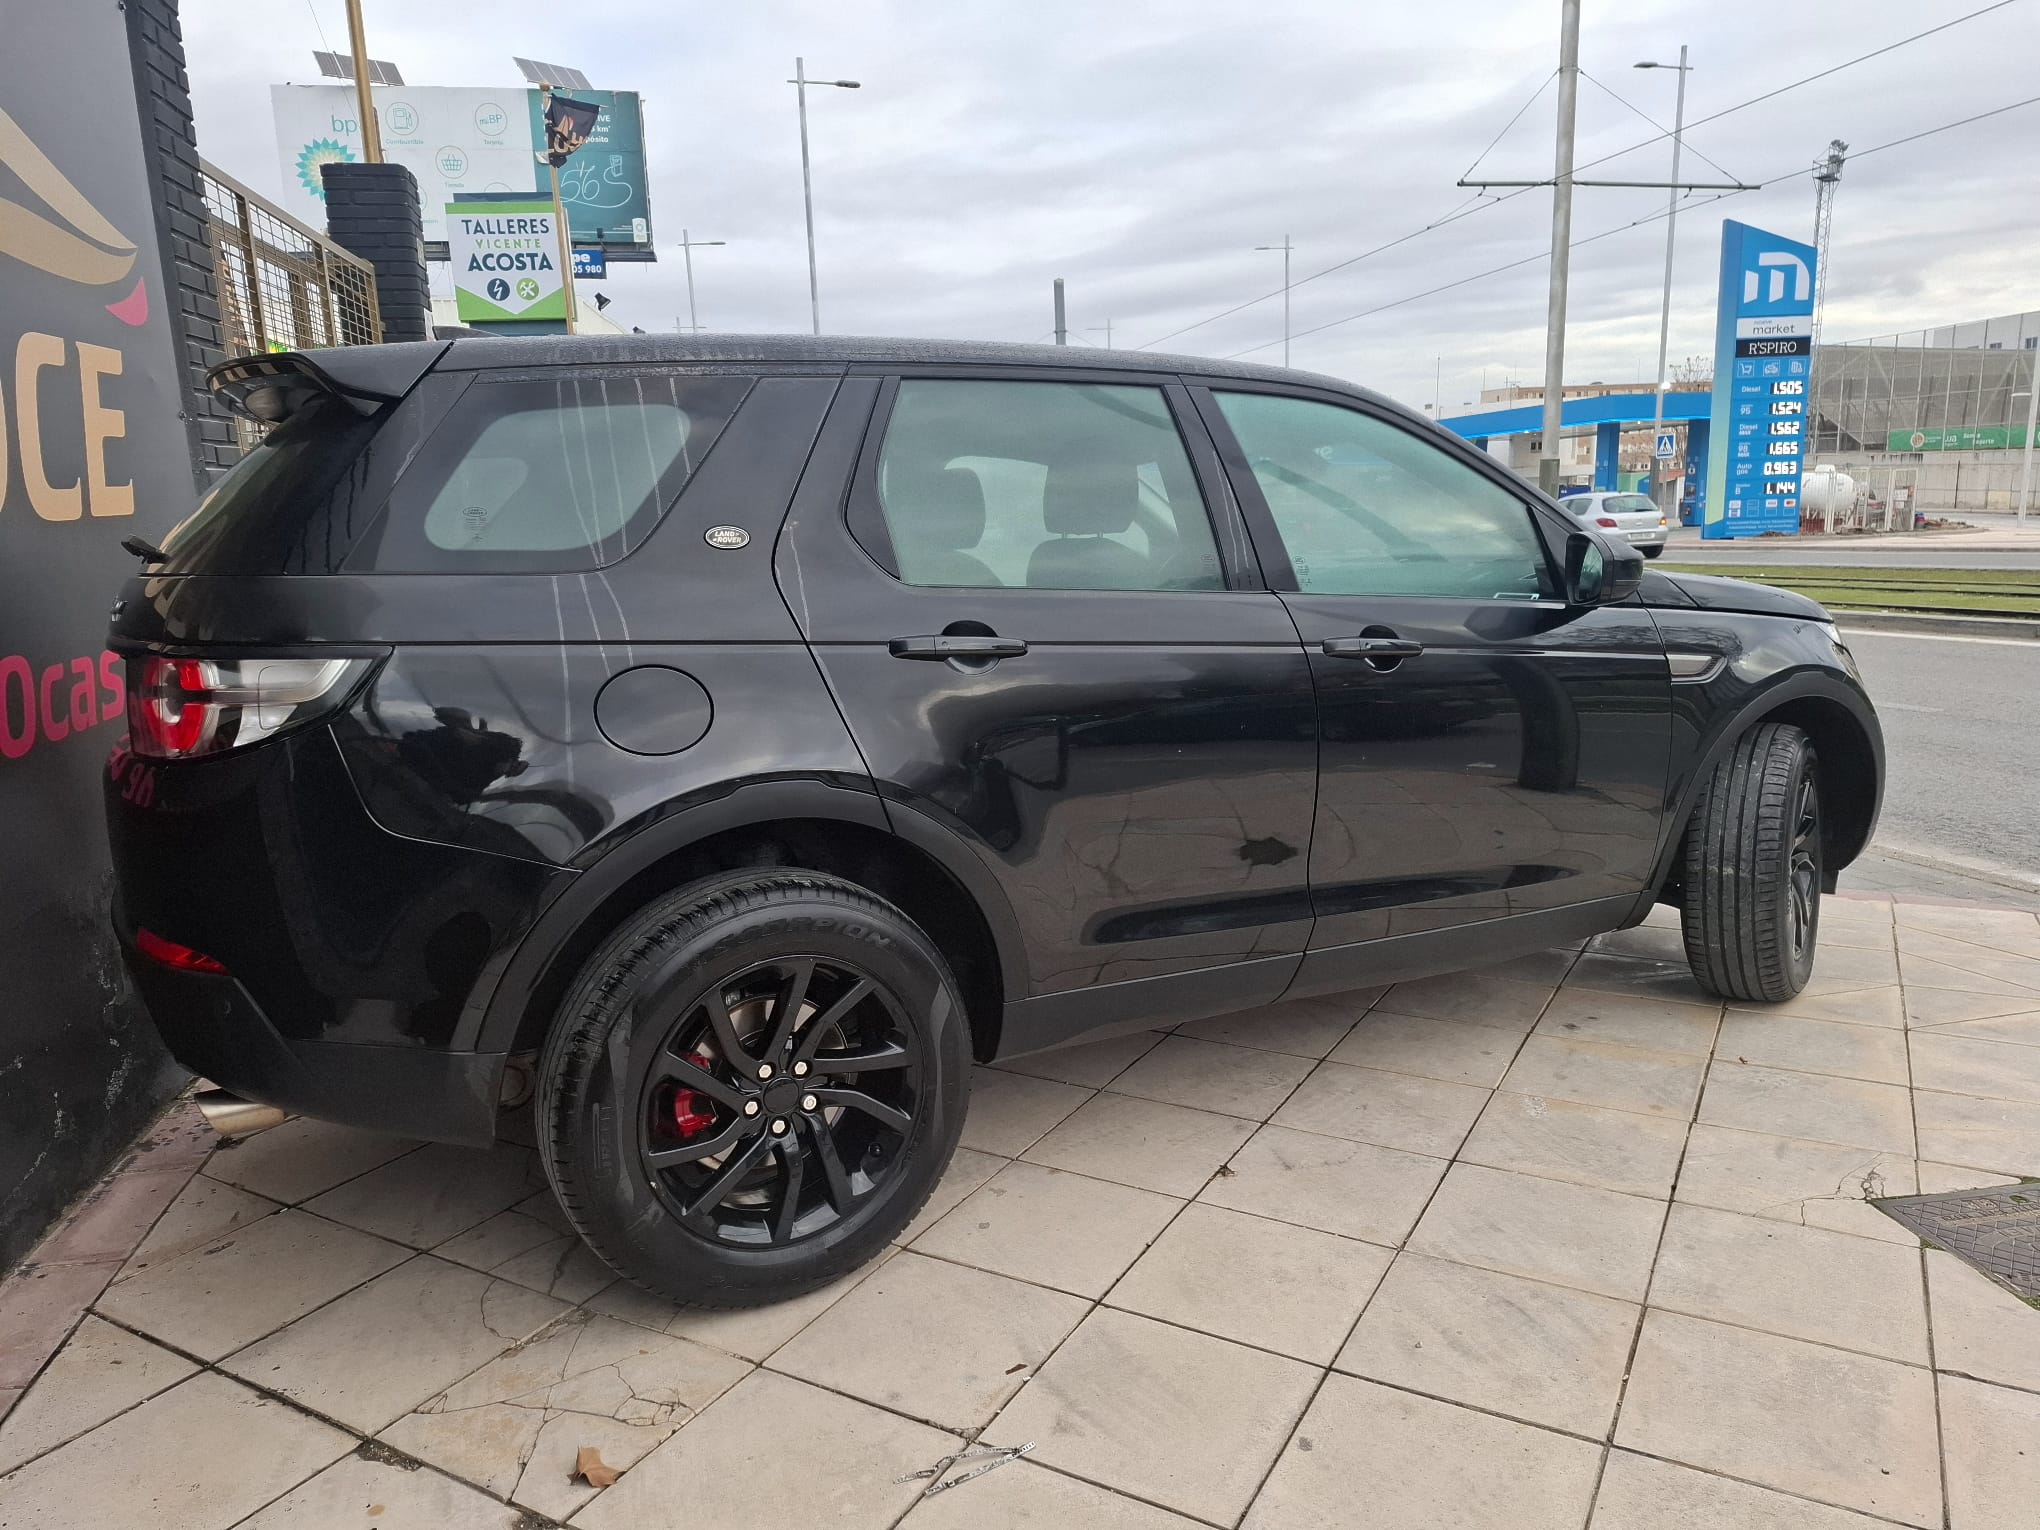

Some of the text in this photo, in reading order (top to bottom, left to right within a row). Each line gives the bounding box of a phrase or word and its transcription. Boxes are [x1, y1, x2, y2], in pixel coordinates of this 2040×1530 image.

[331, 115, 358, 136] bp
[461, 218, 550, 235] TALLERES
[475, 238, 542, 249] VICENTE
[467, 252, 554, 272] ACOSTA
[585, 264, 602, 274] 980
[1752, 324, 1795, 335] market
[1748, 341, 1797, 355] R'SPIRO
[1741, 385, 1761, 393] Diesel
[1739, 423, 1758, 431] Diesel
[1763, 461, 1797, 476] 0.963
